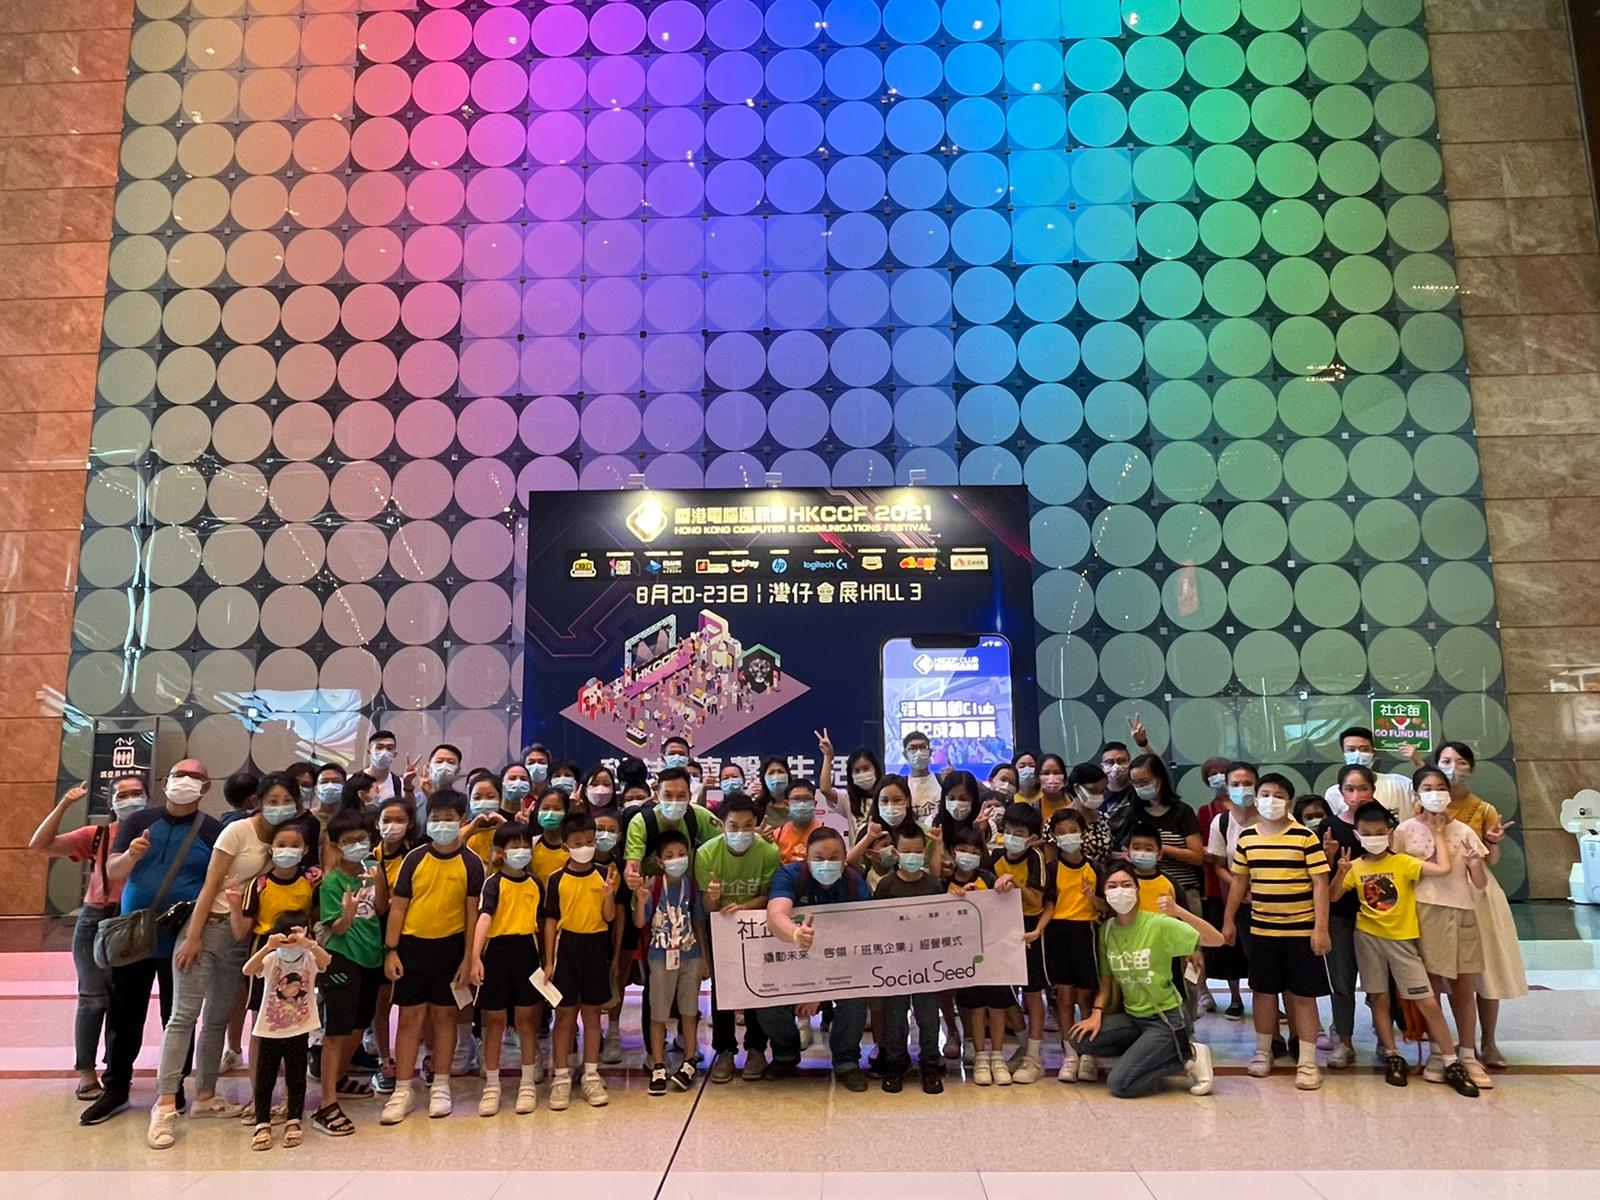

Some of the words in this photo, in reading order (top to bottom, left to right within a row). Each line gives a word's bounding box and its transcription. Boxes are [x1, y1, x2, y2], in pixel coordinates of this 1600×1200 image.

[790, 505, 869, 523] HKCCF
[874, 504, 932, 522] 2021
[674, 526, 702, 536] HONG
[703, 525, 731, 535] KONG
[733, 525, 786, 535] COMPUTER
[797, 523, 881, 533] COMMUNICATIONS
[884, 523, 932, 532] FESTIVAL
[803, 560, 835, 571] logitech
[1380, 703, 1421, 717] 社企苗
[1375, 728, 1388, 737] GO
[1389, 729, 1414, 738] FUND
[1415, 730, 1429, 738] ME
[871, 966, 931, 988] Social
[932, 957, 977, 983] Seed
